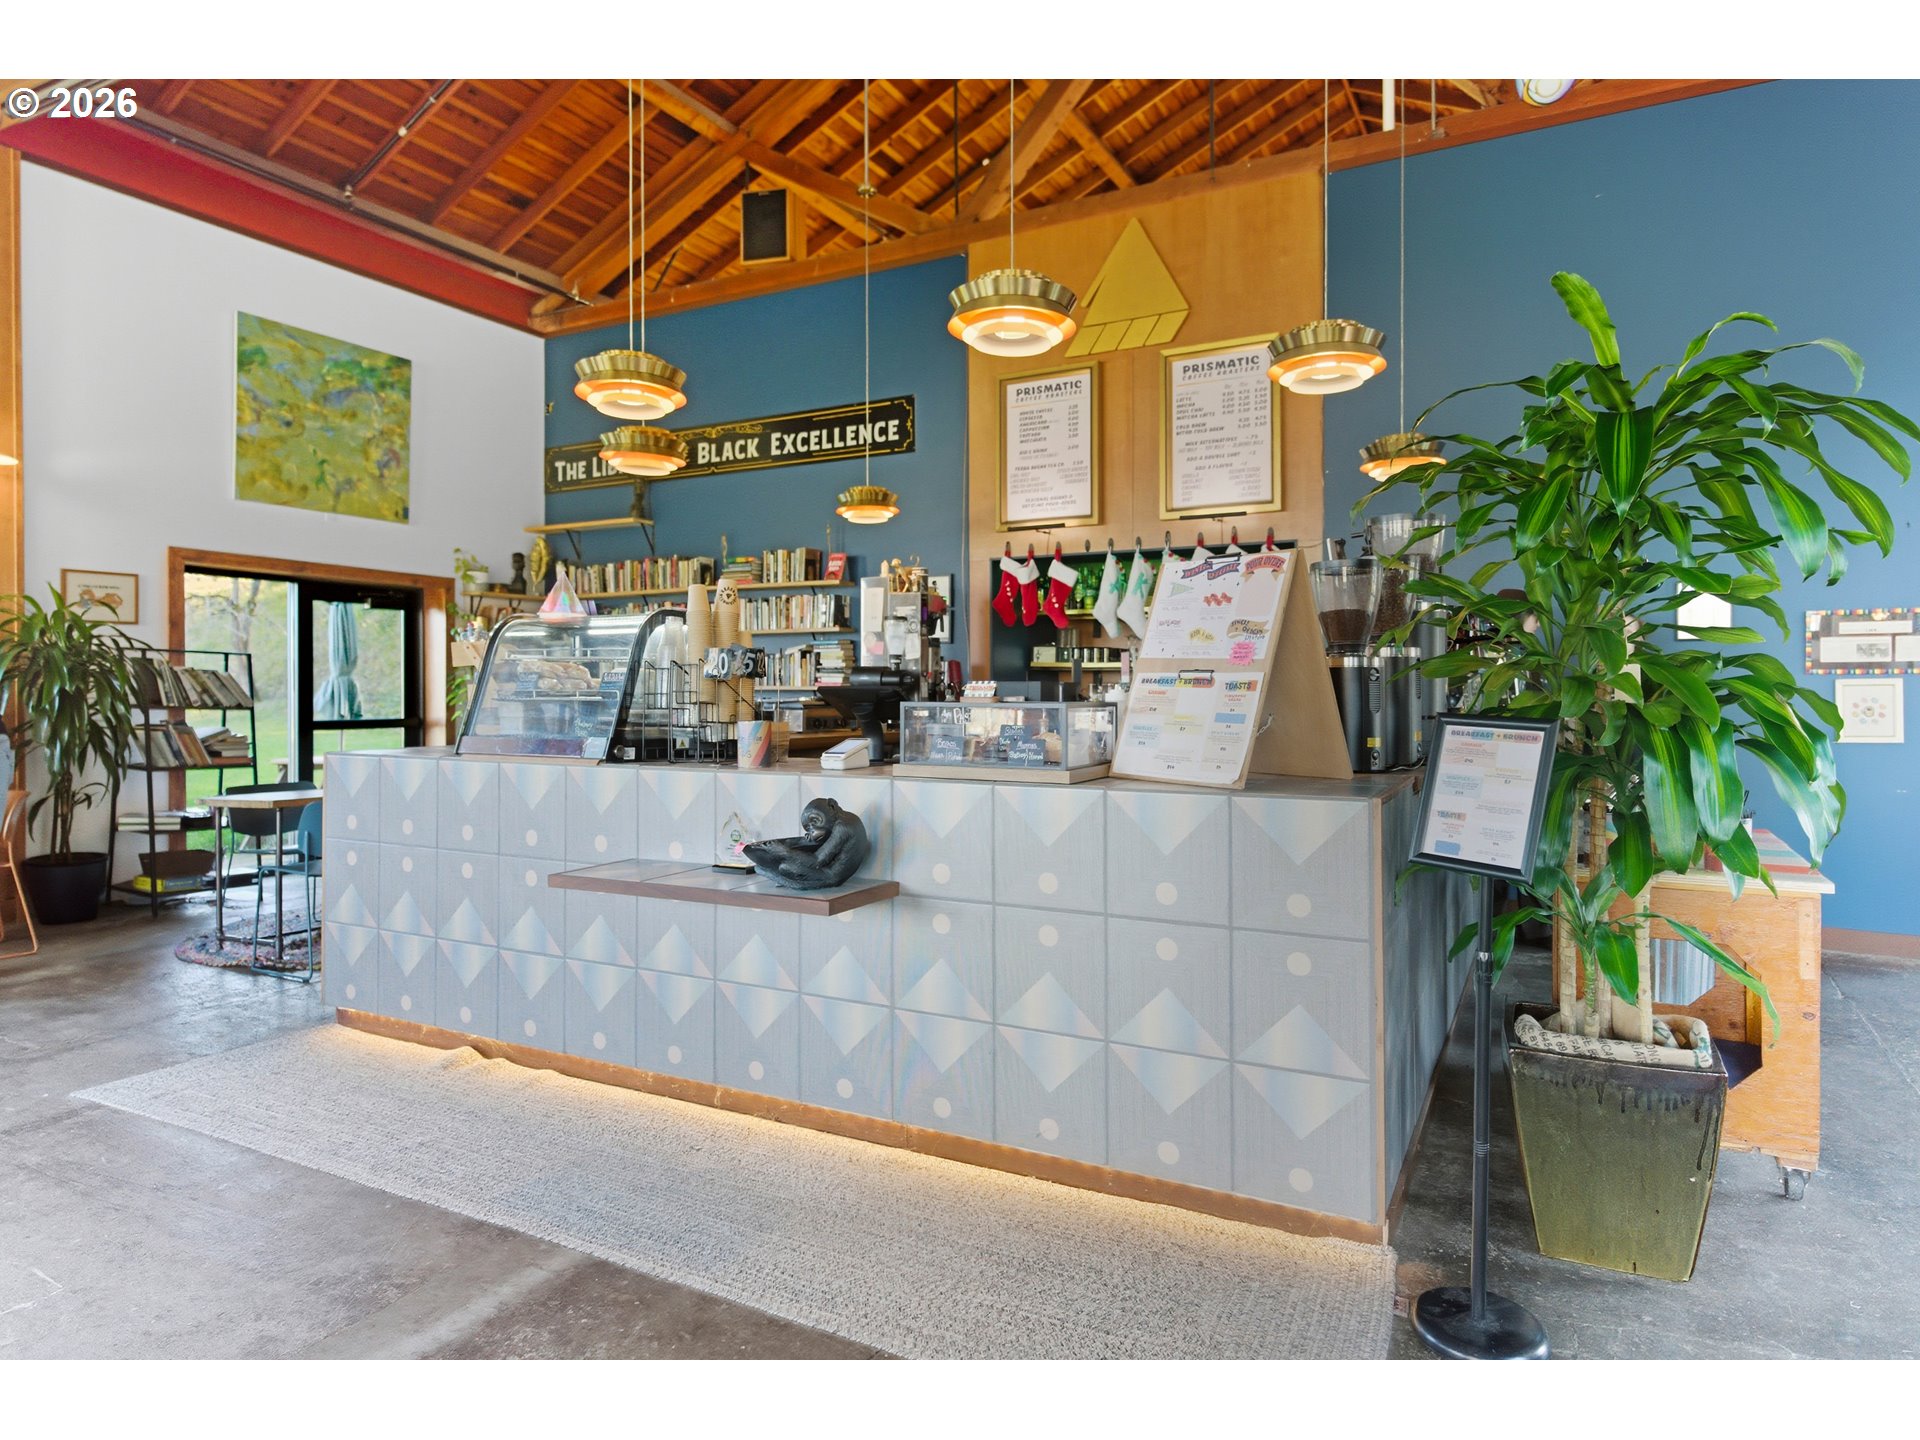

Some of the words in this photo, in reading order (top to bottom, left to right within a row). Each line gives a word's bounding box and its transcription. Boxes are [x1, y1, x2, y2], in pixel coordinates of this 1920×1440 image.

[1183, 355, 1260, 375] PRISMATIC
[1182, 372, 1212, 381] COFFEE
[1216, 365, 1260, 376] ROASTERS
[1015, 395, 1042, 403] COFFEE
[1045, 389, 1082, 399] ROASTERS
[1016, 380, 1082, 397] PRISMATIC
[697, 437, 760, 465] BLACK
[770, 419, 900, 457] EXCELLENCE
[1141, 678, 1177, 686] BREAKFAST
[1183, 678, 1212, 686] BRUNCH
[1225, 680, 1252, 690] TOASTS
[1450, 730, 1495, 740] BREAKFAST
[1502, 733, 1538, 742] BRUNCH
